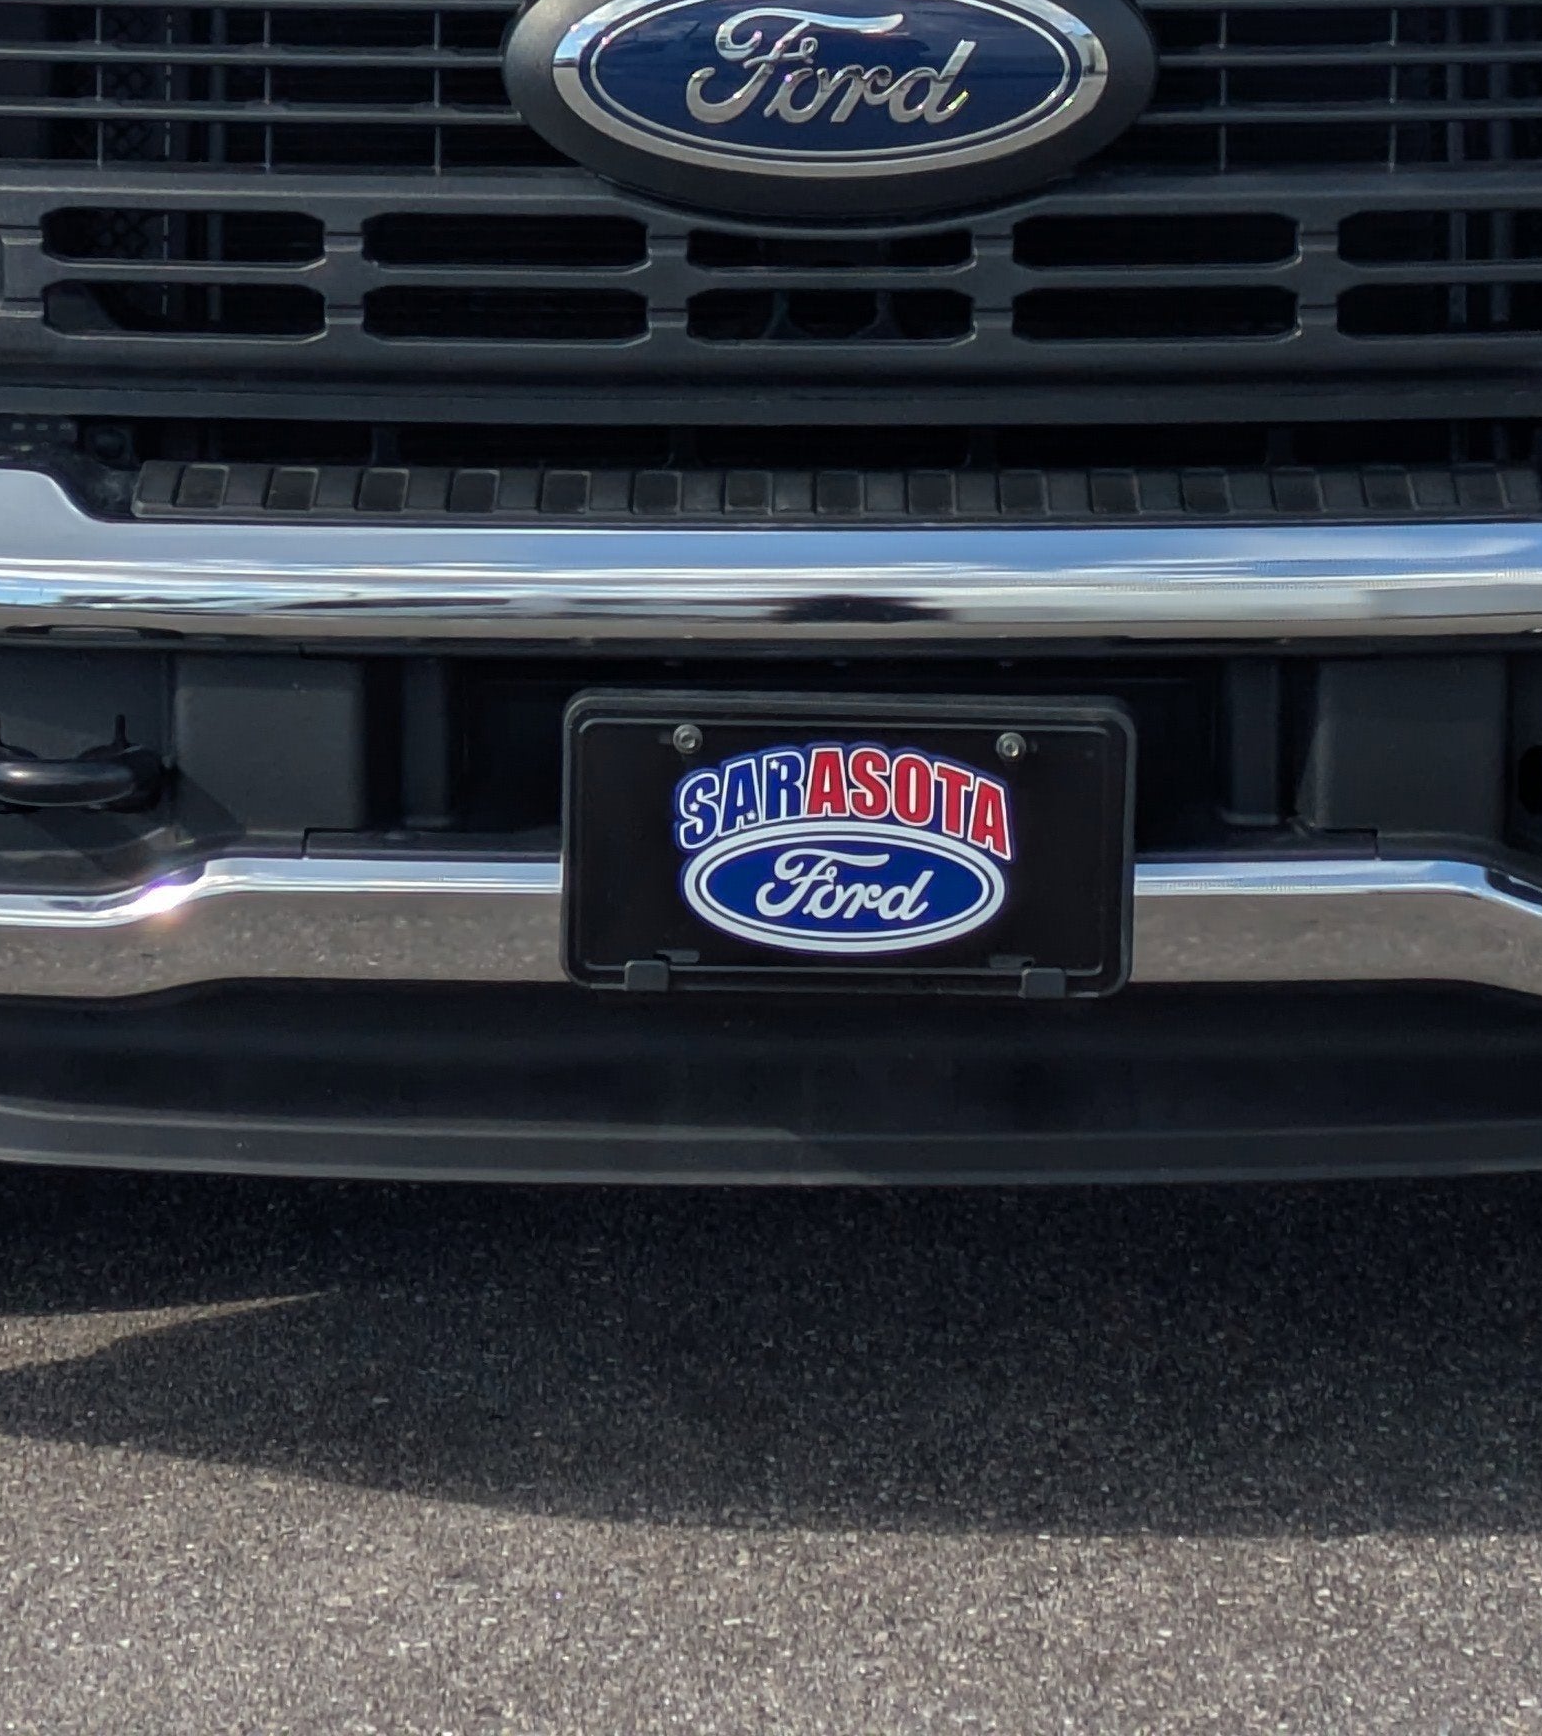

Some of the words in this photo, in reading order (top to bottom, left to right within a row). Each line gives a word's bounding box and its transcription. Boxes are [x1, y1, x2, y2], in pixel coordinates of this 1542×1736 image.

[685, 6, 977, 125] Ford
[677, 746, 1014, 862] SARASOTA
[755, 848, 935, 922] Ford
